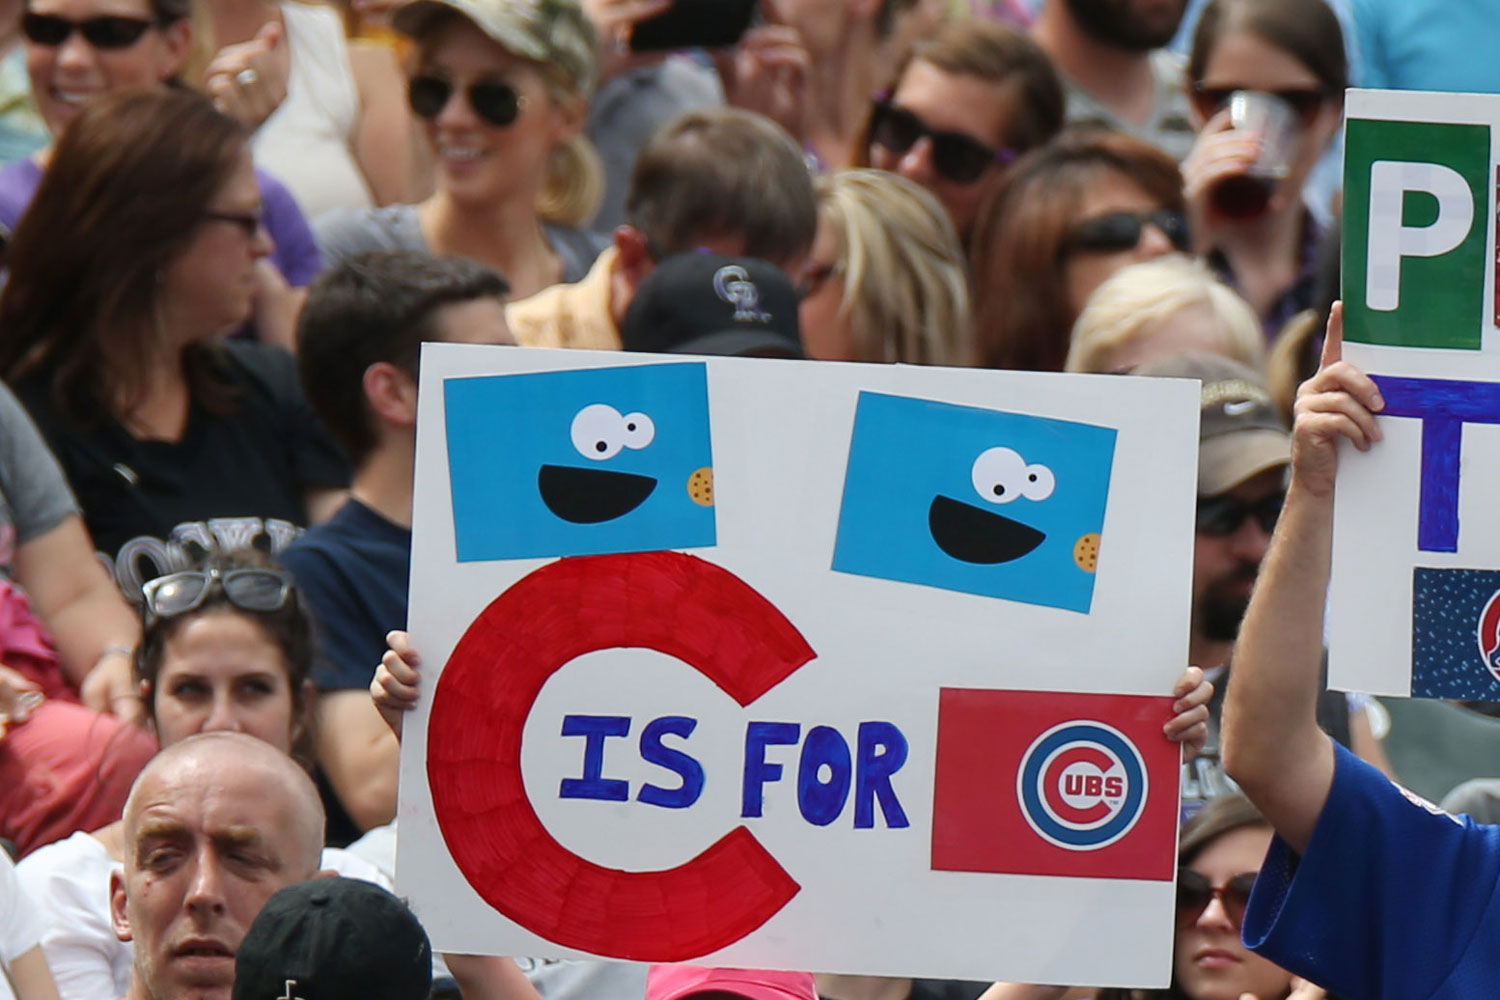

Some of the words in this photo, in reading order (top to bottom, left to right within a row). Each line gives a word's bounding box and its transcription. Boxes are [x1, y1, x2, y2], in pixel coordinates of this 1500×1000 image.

[426, 549, 818, 963] C
[558, 714, 706, 809] IS
[740, 719, 911, 829] FOR
